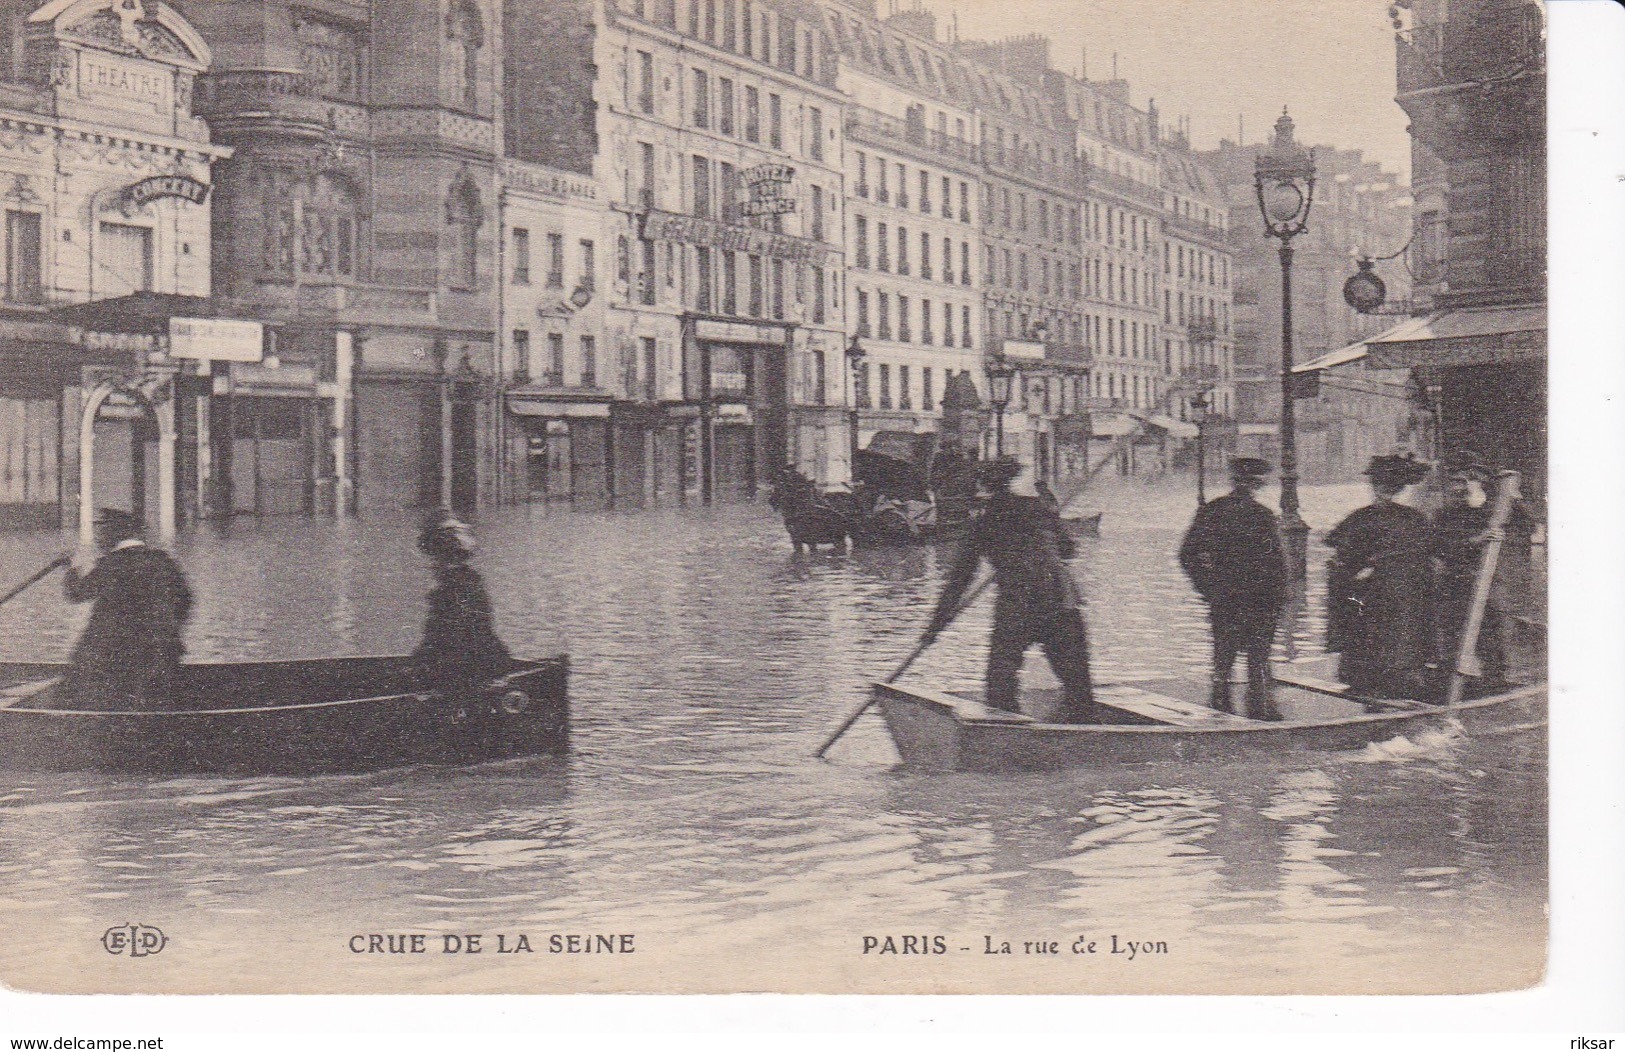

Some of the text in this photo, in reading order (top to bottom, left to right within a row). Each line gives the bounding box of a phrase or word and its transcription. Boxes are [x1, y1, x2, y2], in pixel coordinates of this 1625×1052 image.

[88, 63, 159, 96] THEATRE
[132, 178, 202, 201] CONCERT
[741, 199, 796, 215] FRANCE
